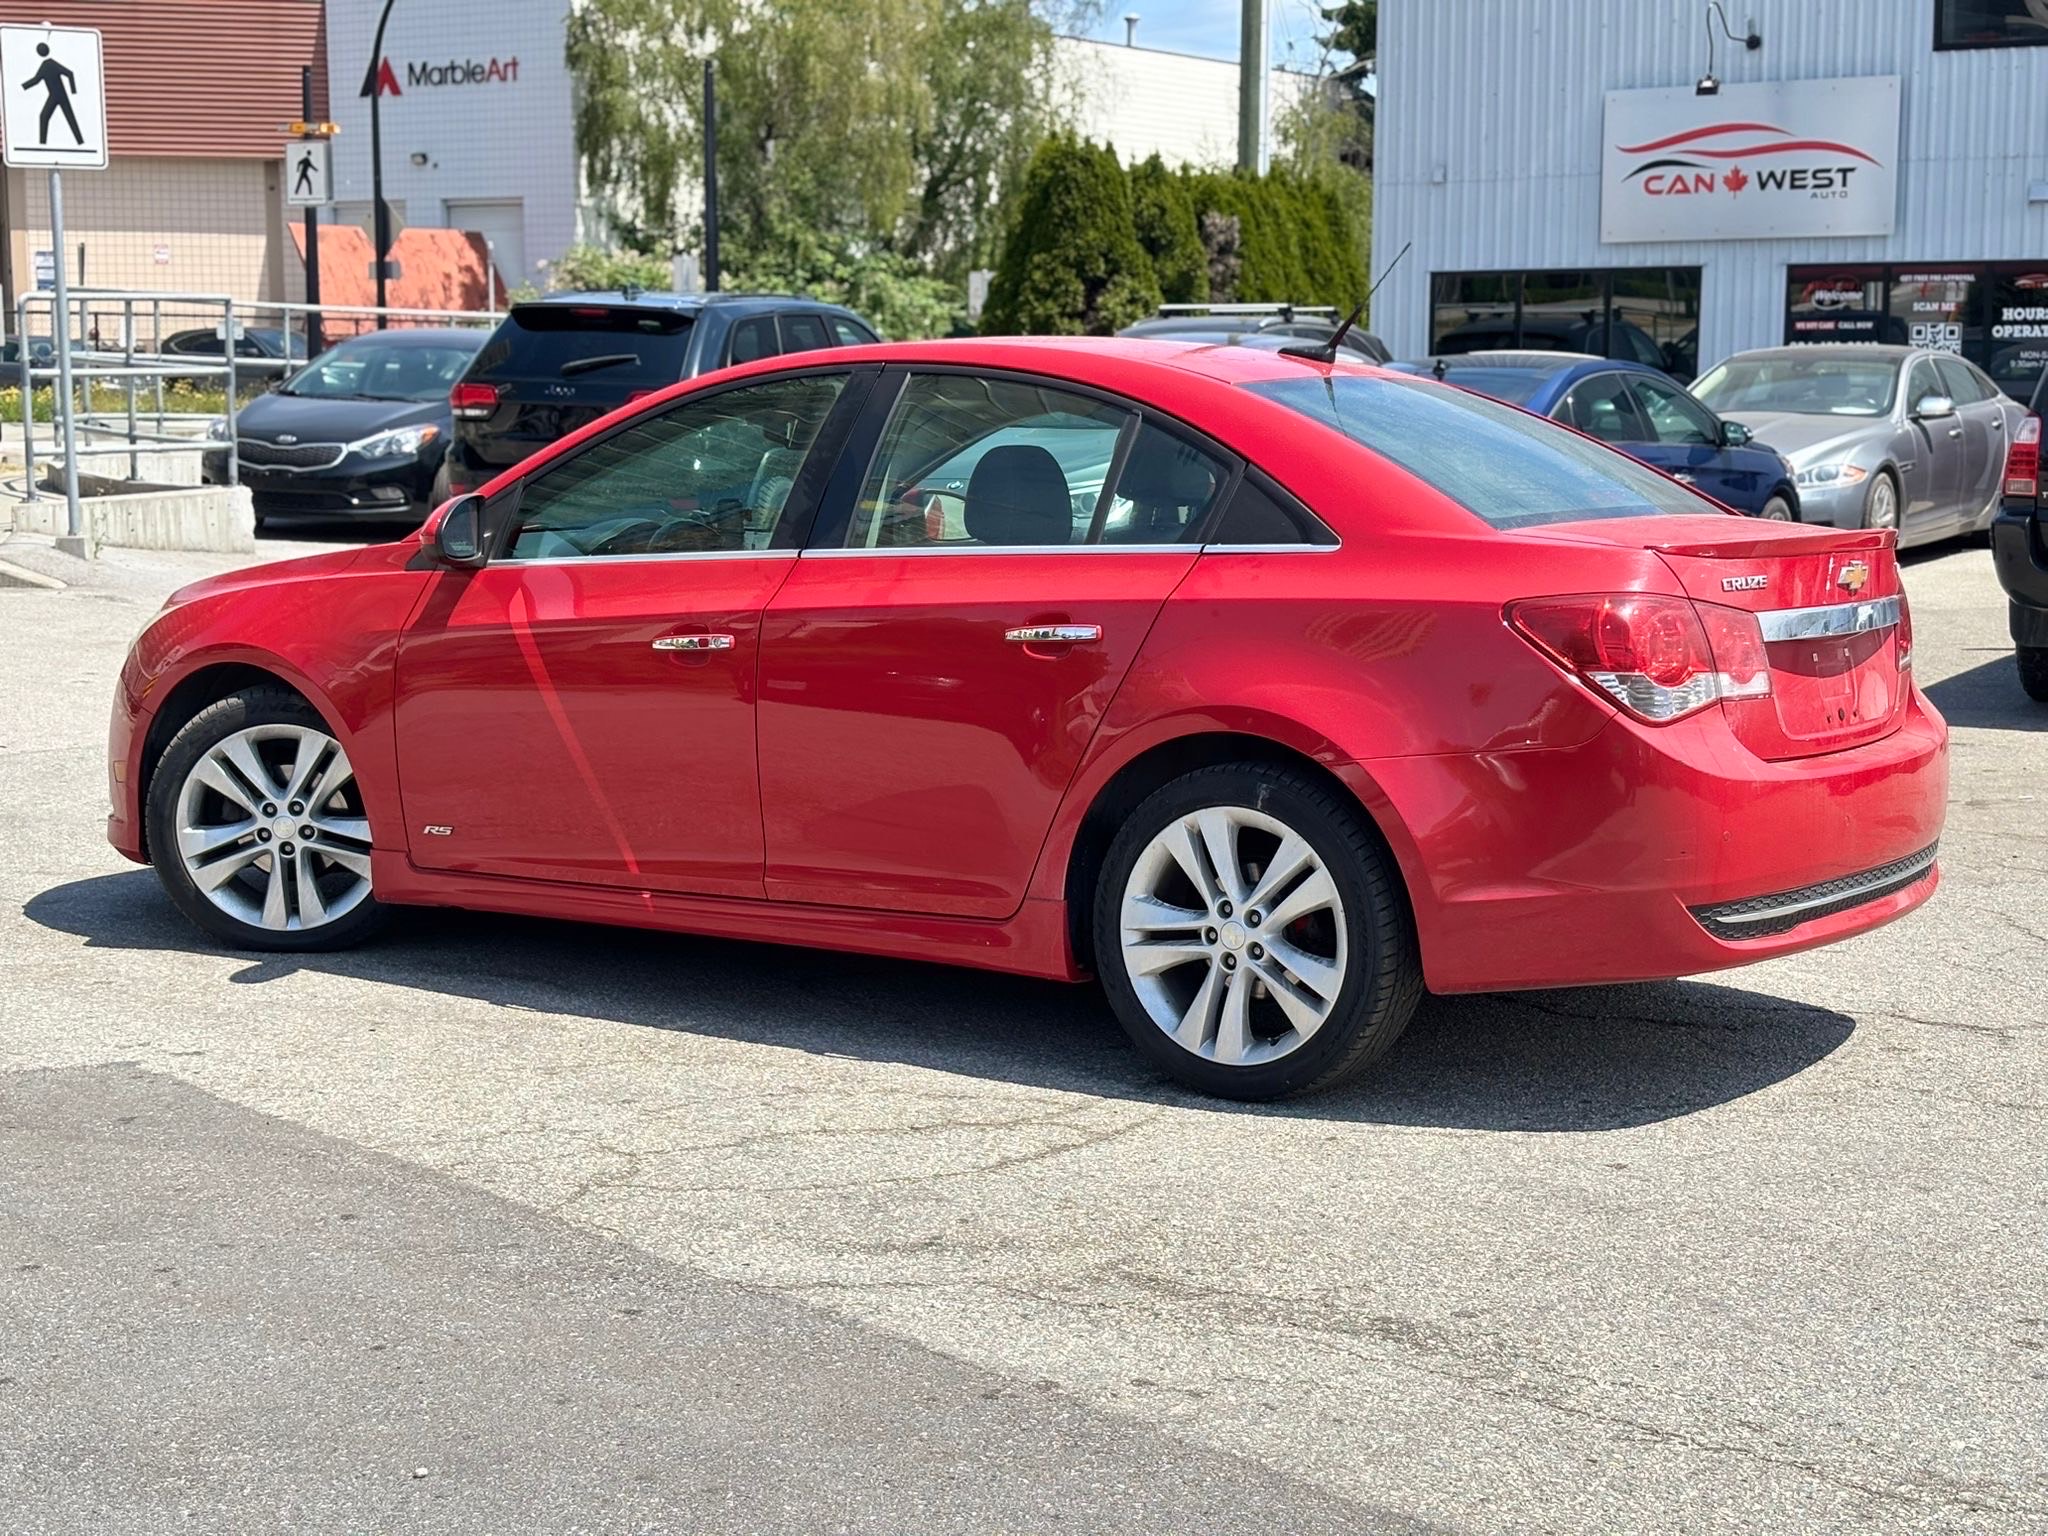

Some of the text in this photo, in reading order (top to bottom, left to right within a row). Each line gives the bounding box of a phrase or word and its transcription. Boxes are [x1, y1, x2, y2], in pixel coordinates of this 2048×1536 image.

[407, 56, 519, 87] MarbleArt
[1644, 167, 1857, 196] CAN WEST
[1810, 190, 1848, 199] AUTO
[1815, 289, 1864, 301] Welcome
[1912, 302, 1956, 312] SCAN ME
[1721, 575, 1768, 592] CRUZE
[423, 824, 454, 836] RS
